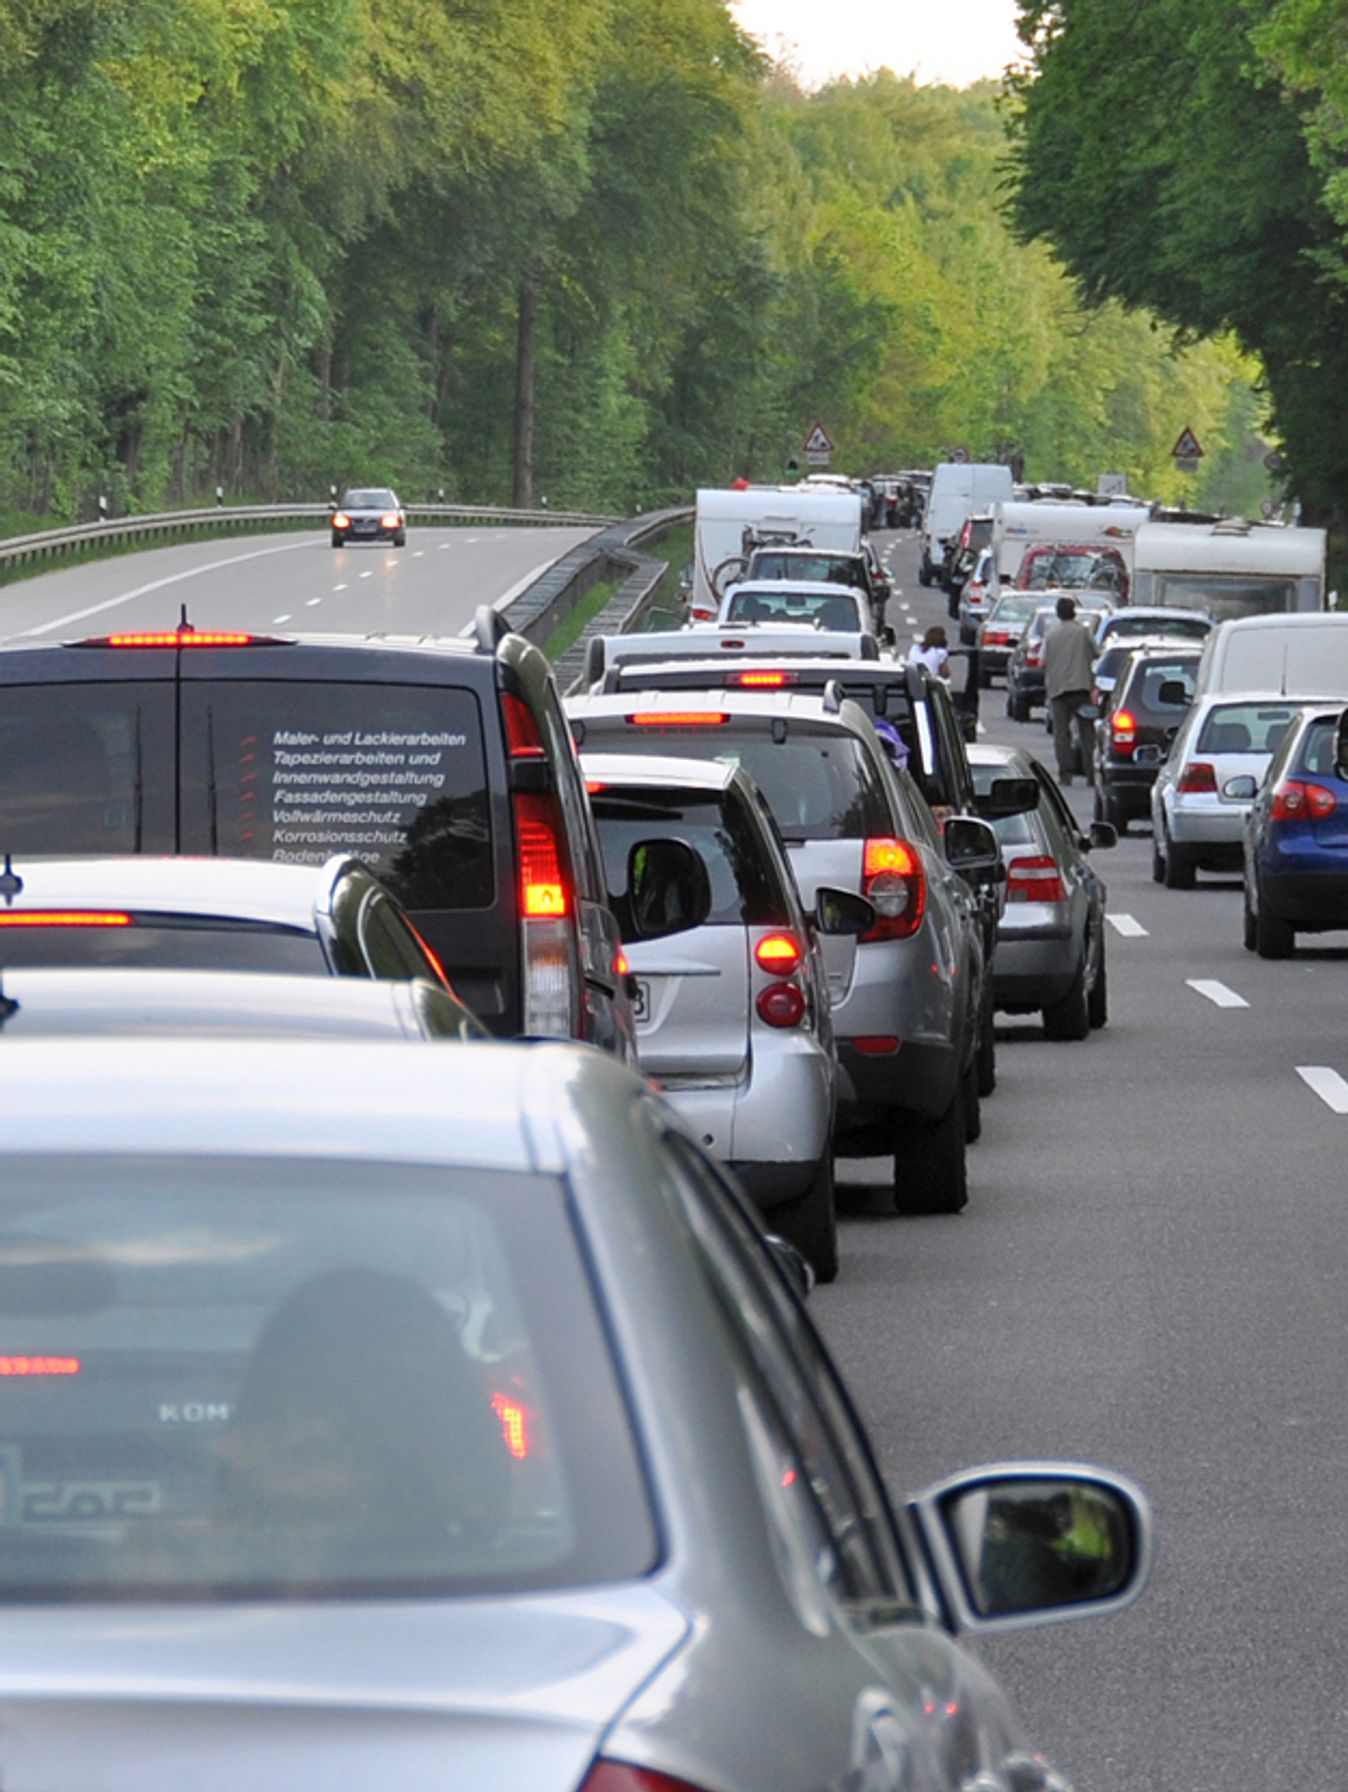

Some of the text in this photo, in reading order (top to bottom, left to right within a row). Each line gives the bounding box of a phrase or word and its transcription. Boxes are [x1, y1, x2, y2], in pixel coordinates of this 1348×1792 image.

[272, 731, 467, 746] Maler- und Lackierarbeiten
[273, 750, 442, 766] Tapezierarbeiten und
[272, 771, 445, 787] Innenwandgestaltung
[273, 789, 427, 806] Fassadengestaltung
[272, 810, 401, 824] Vollwärmeschutz
[272, 829, 408, 843] Korrosionsschutz
